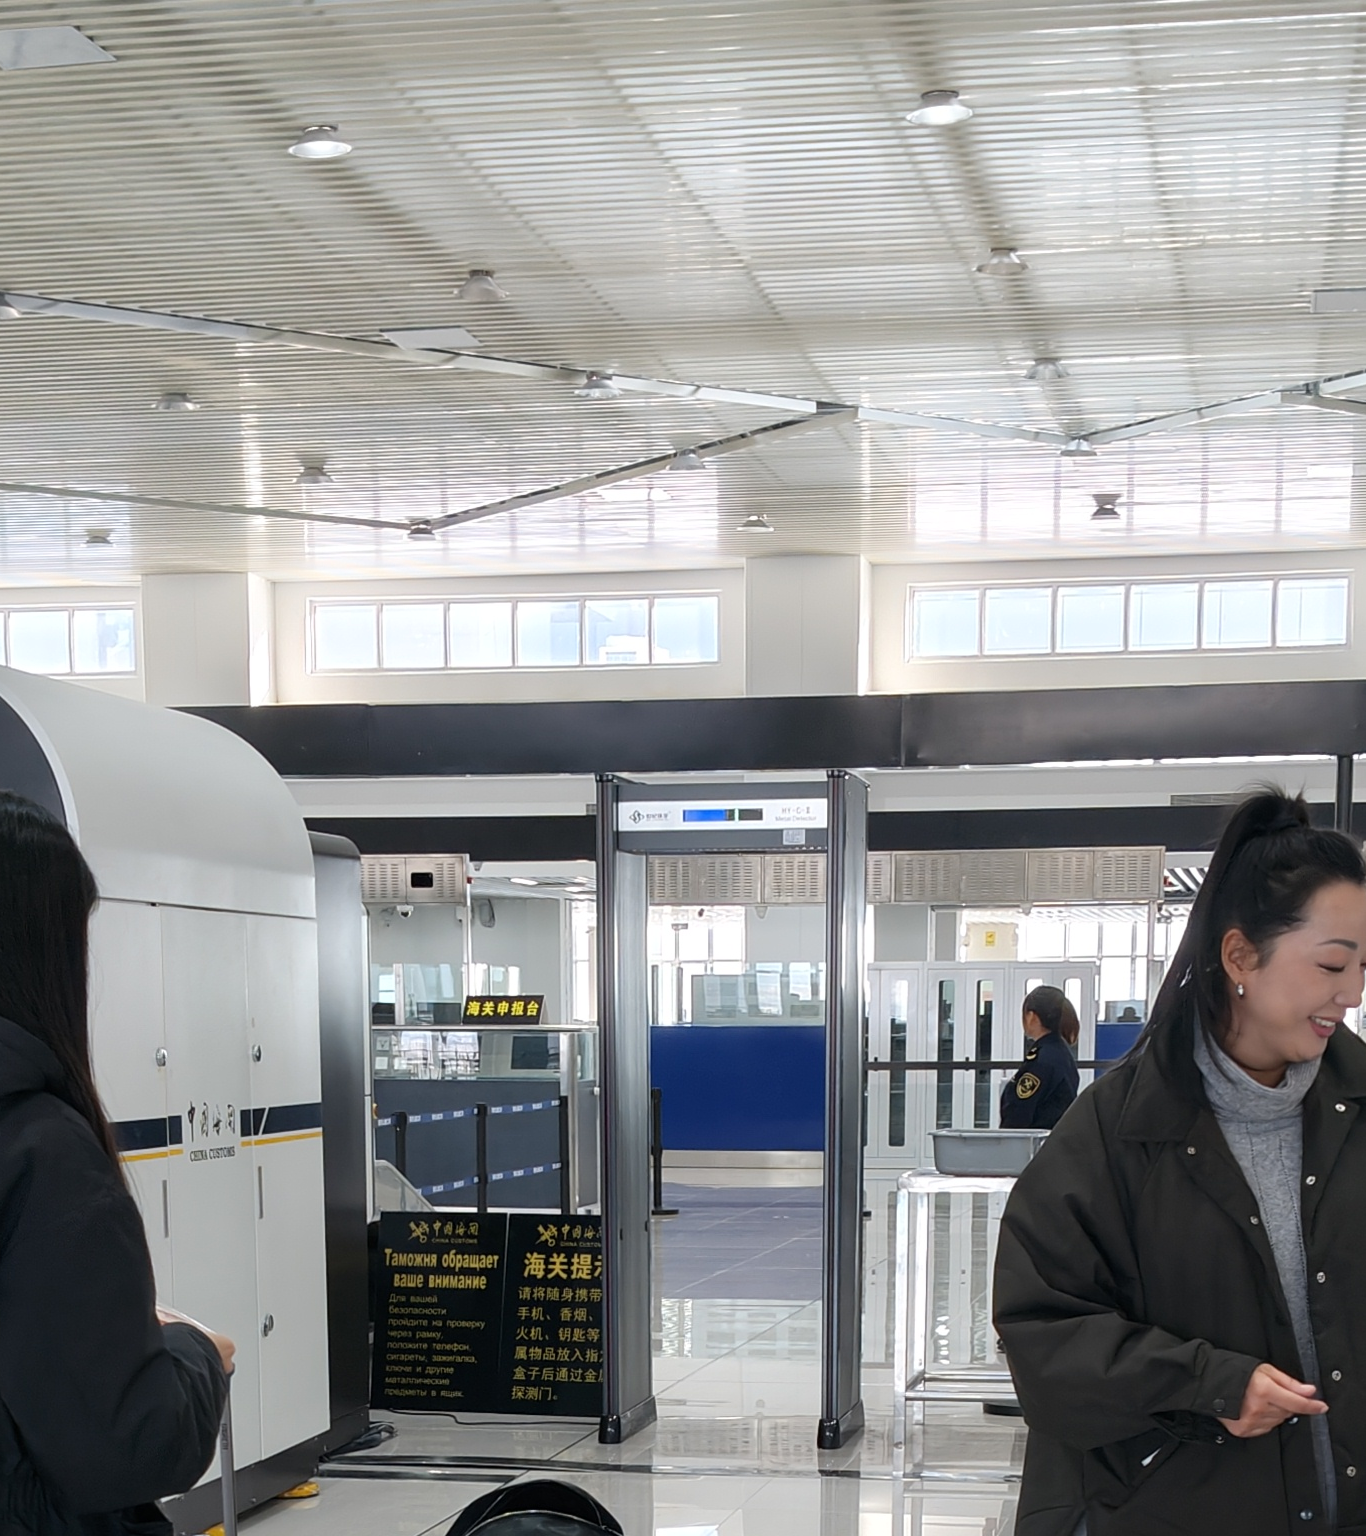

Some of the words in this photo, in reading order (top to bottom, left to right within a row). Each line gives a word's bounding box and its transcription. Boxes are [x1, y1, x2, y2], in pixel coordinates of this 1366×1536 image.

[466, 1001, 539, 1017] 海关申报台
[190, 1149, 208, 1162] CHINA
[209, 1146, 235, 1160] CUSTOMS
[384, 1248, 437, 1267] Таможня
[442, 1249, 499, 1272] обращает
[393, 1273, 423, 1288] ваше
[428, 1274, 487, 1289] внимание
[388, 1293, 406, 1303] Для
[410, 1294, 438, 1303] вашей
[518, 1286, 603, 1302] 请将随身携带
[388, 1305, 447, 1315] безопасности
[388, 1318, 428, 1327] пройдите
[446, 1320, 485, 1329] проверку
[387, 1330, 412, 1338] через
[387, 1342, 428, 1350] положите
[425, 1366, 454, 1375] другие
